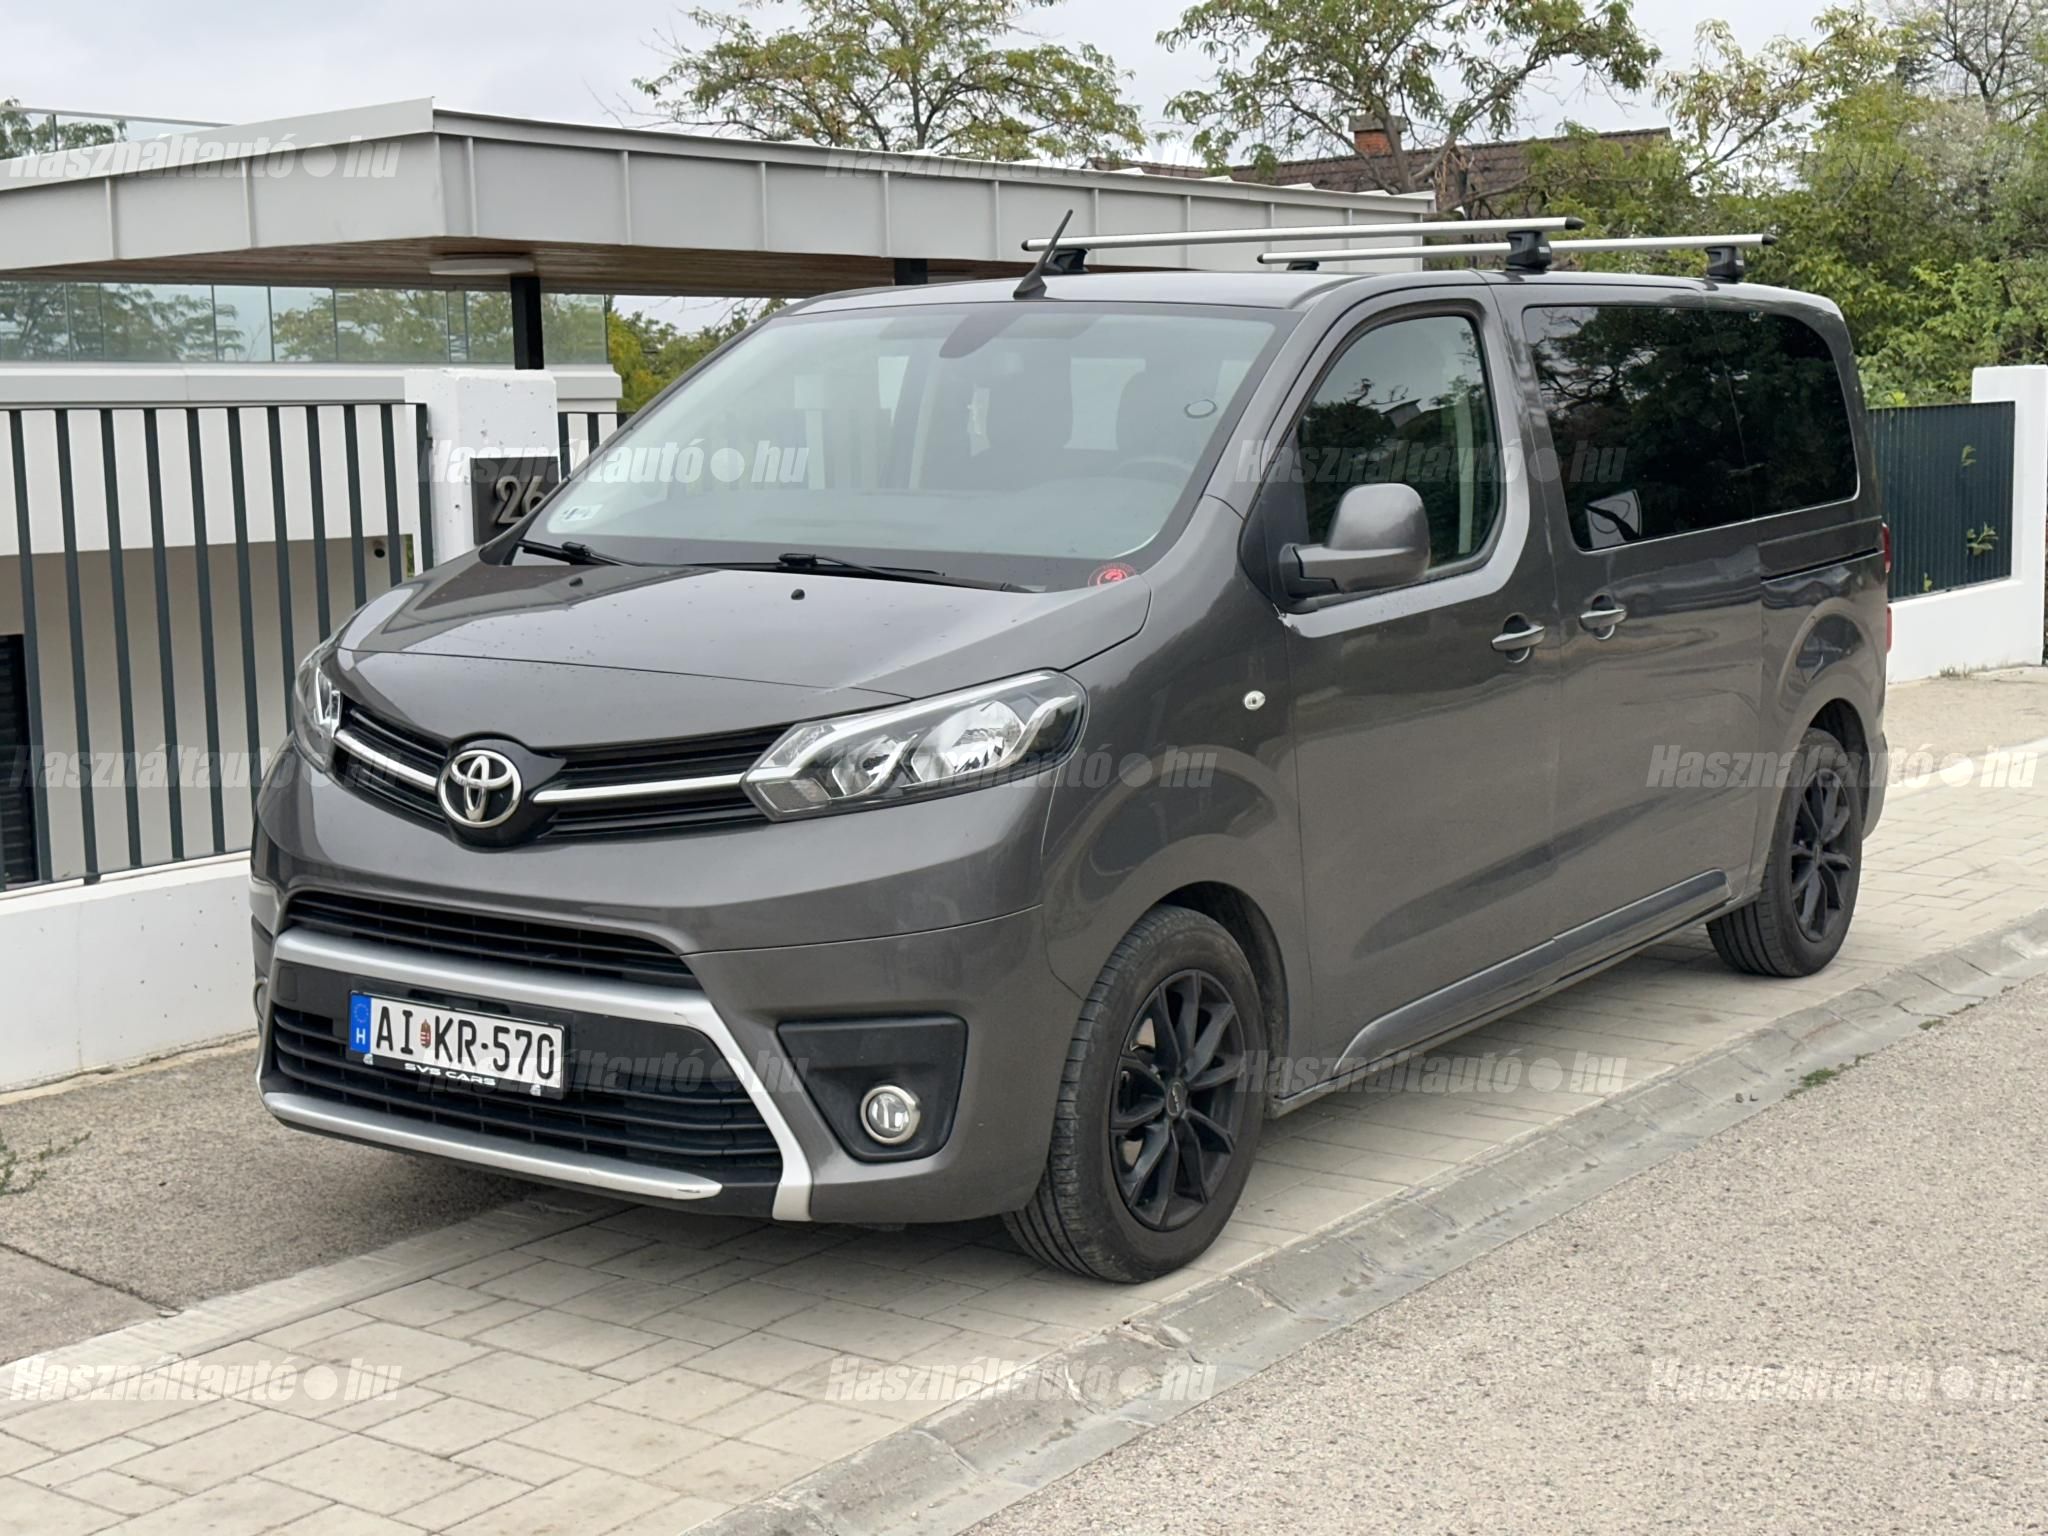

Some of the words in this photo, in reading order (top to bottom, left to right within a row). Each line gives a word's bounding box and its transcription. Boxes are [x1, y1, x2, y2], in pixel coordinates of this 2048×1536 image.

[496, 475, 547, 523] 26
[356, 1028, 366, 1045] H
[434, 1015, 555, 1080] KR-570
[445, 1070, 496, 1086] CARS
